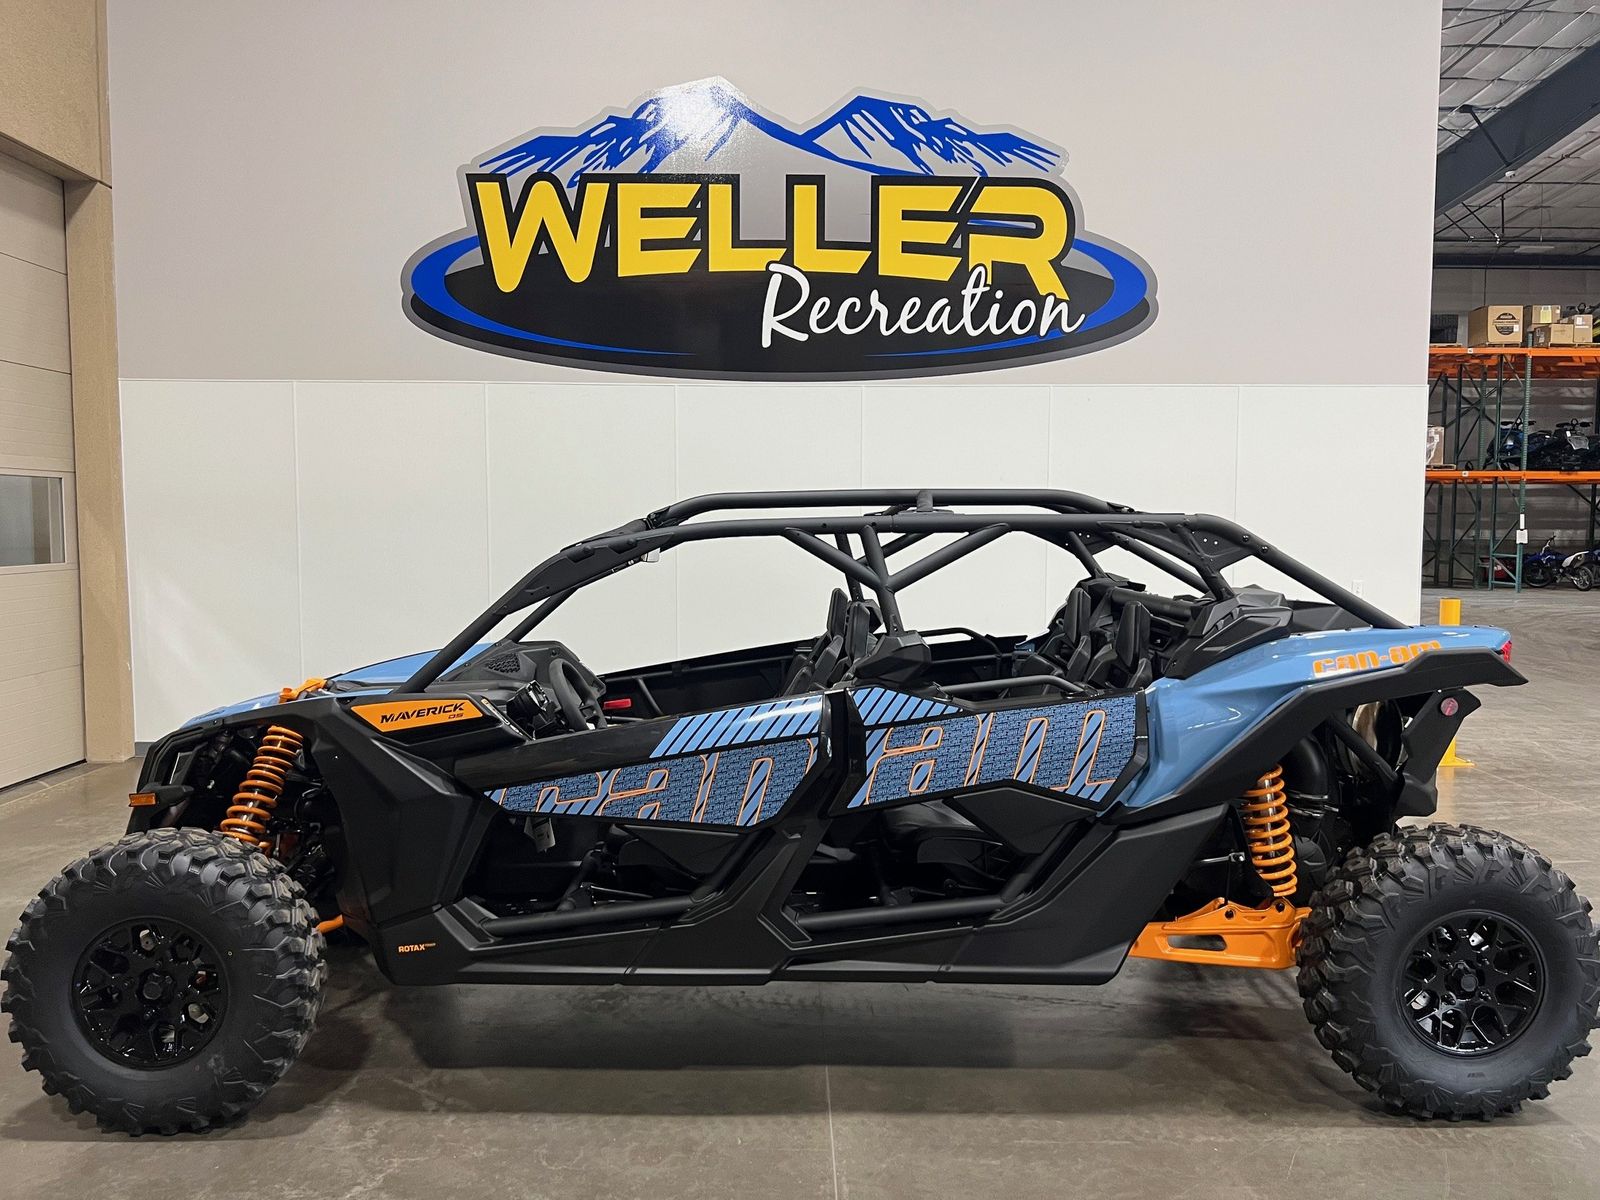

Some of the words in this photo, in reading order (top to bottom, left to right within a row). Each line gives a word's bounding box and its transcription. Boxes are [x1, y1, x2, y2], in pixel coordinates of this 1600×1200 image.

[476, 182, 1070, 300] WELLER
[761, 264, 1087, 348] Recreation
[380, 702, 465, 724] MAVERICK
[398, 943, 426, 953] ROTAX
